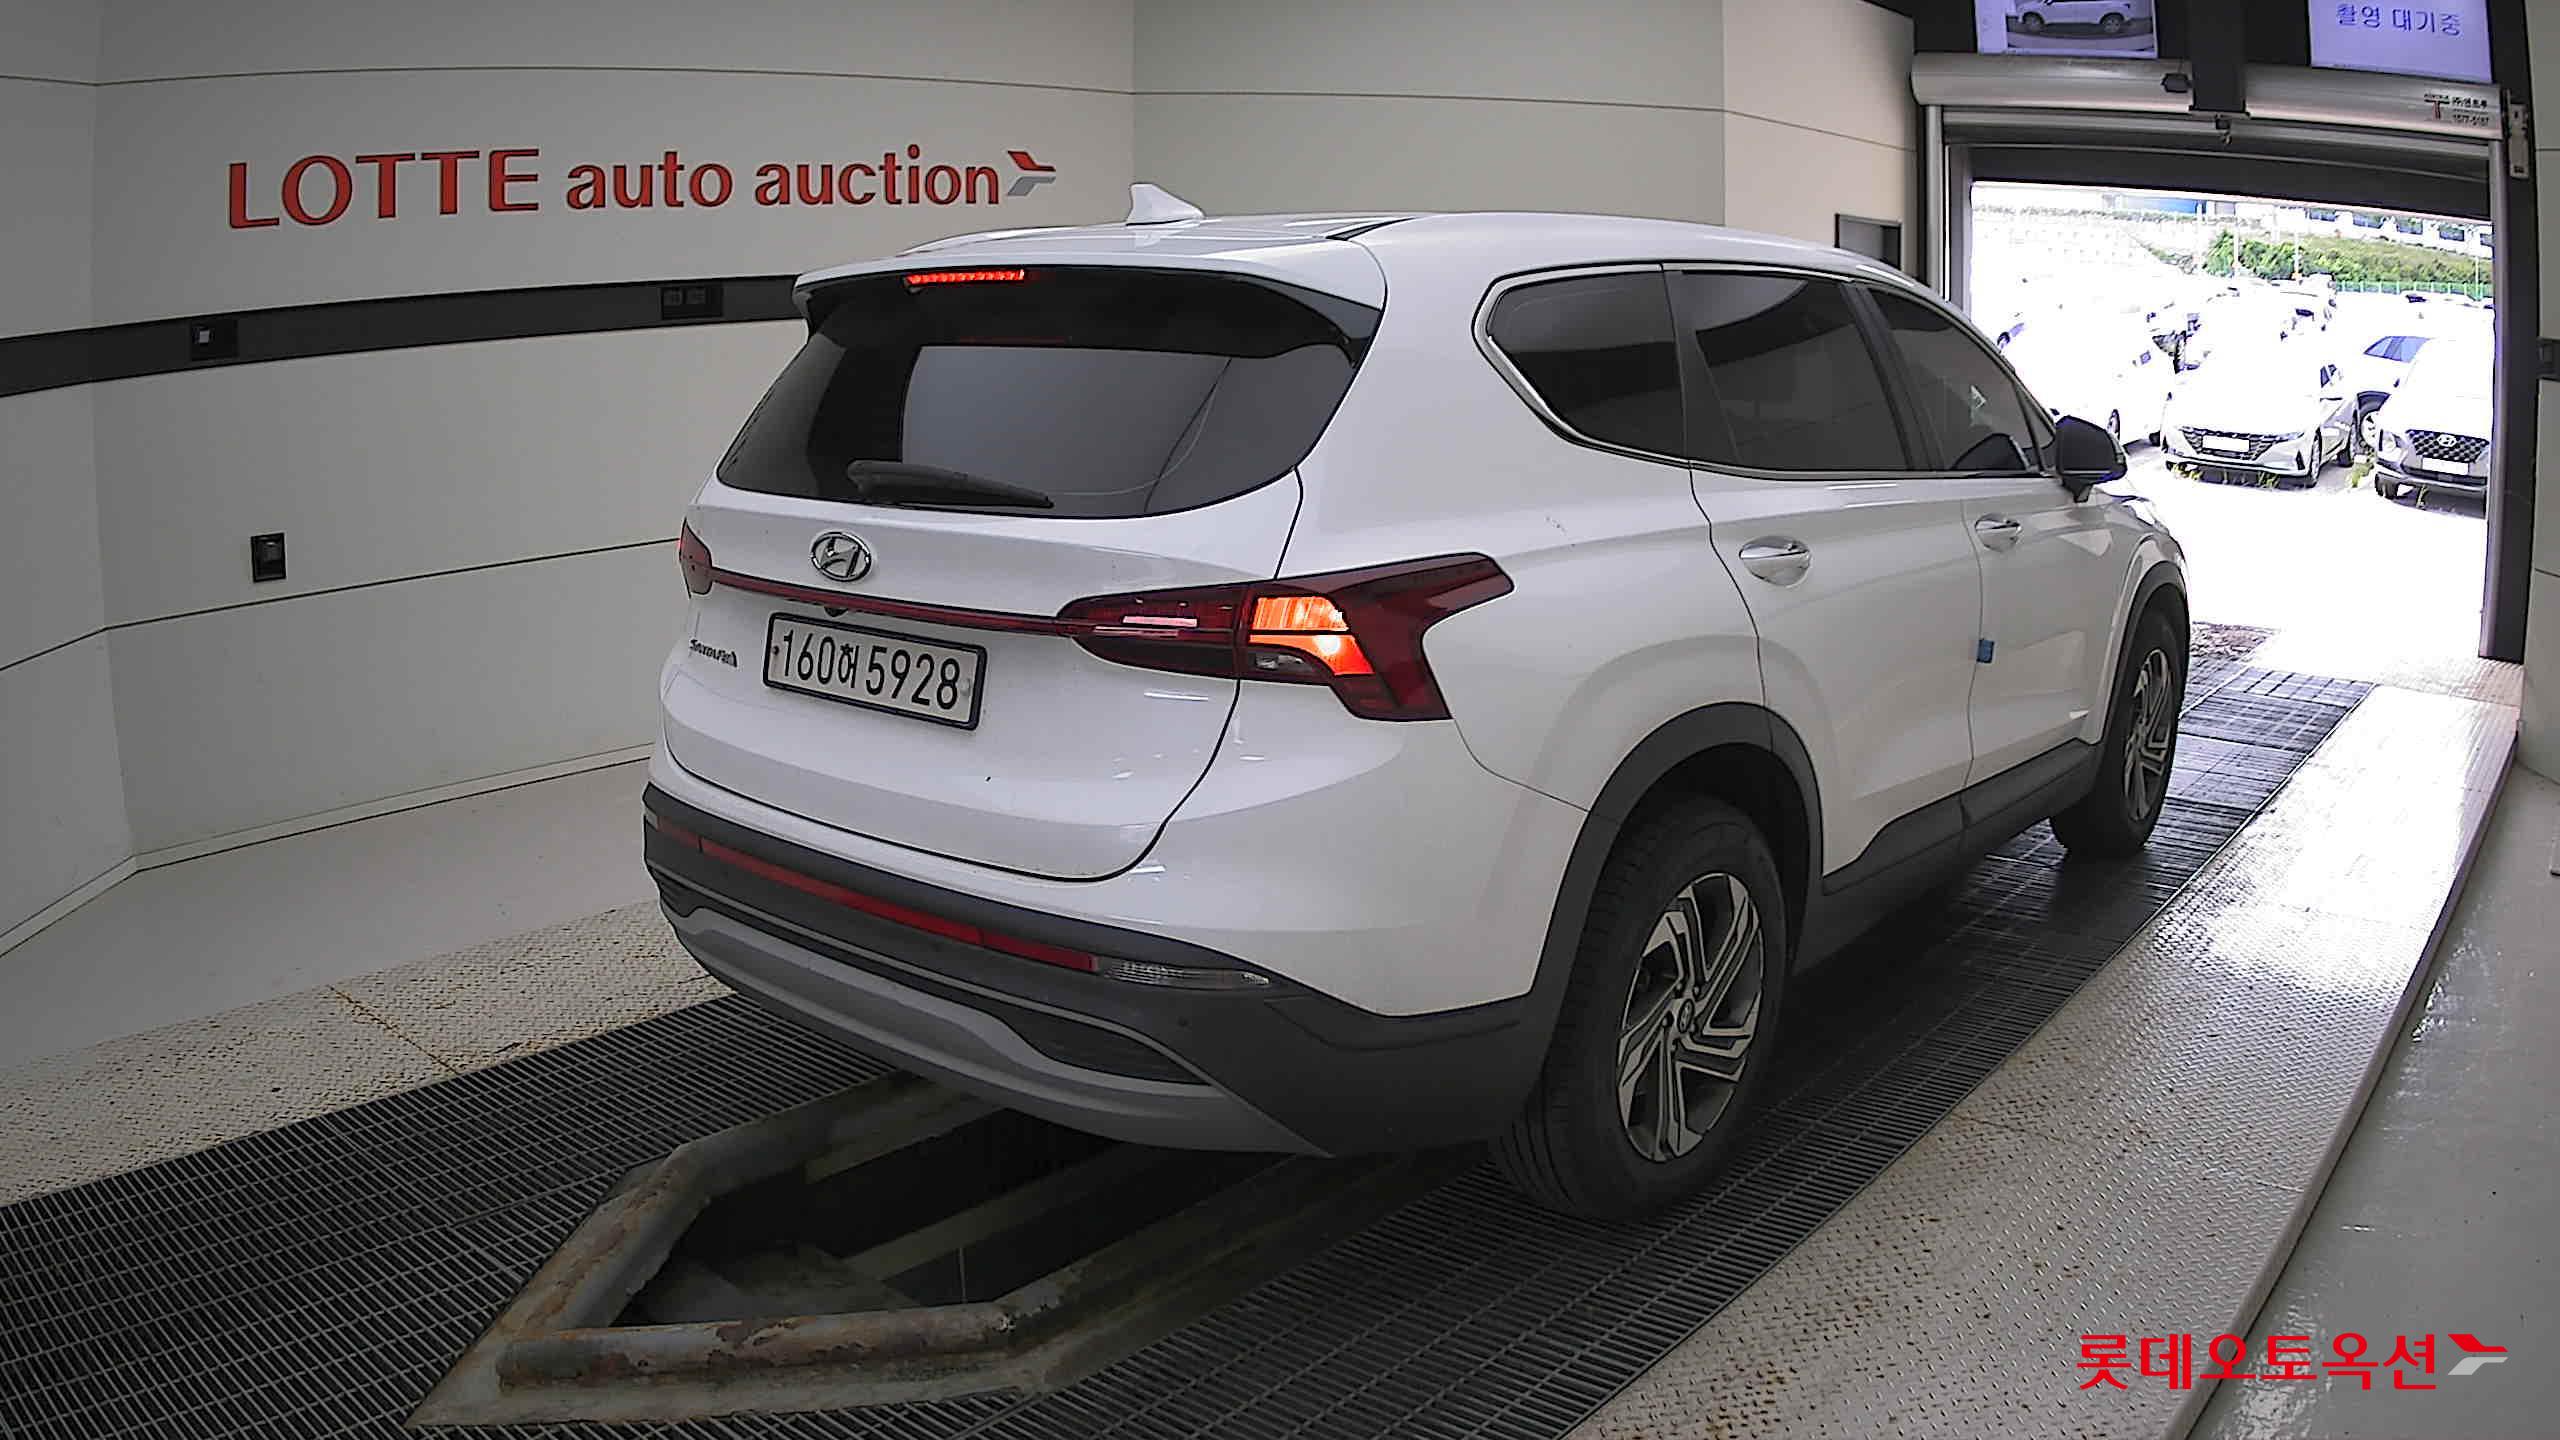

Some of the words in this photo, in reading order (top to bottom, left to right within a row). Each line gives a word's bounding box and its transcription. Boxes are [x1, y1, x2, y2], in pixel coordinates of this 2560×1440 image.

[2338, 4, 2381, 28] 촬영
[2391, 9, 2460, 36] 대기중
[228, 148, 541, 230] LOTTE
[566, 150, 733, 210] auto
[753, 143, 1002, 206] auction
[783, 629, 860, 690] 160허
[865, 645, 961, 710] 5928
